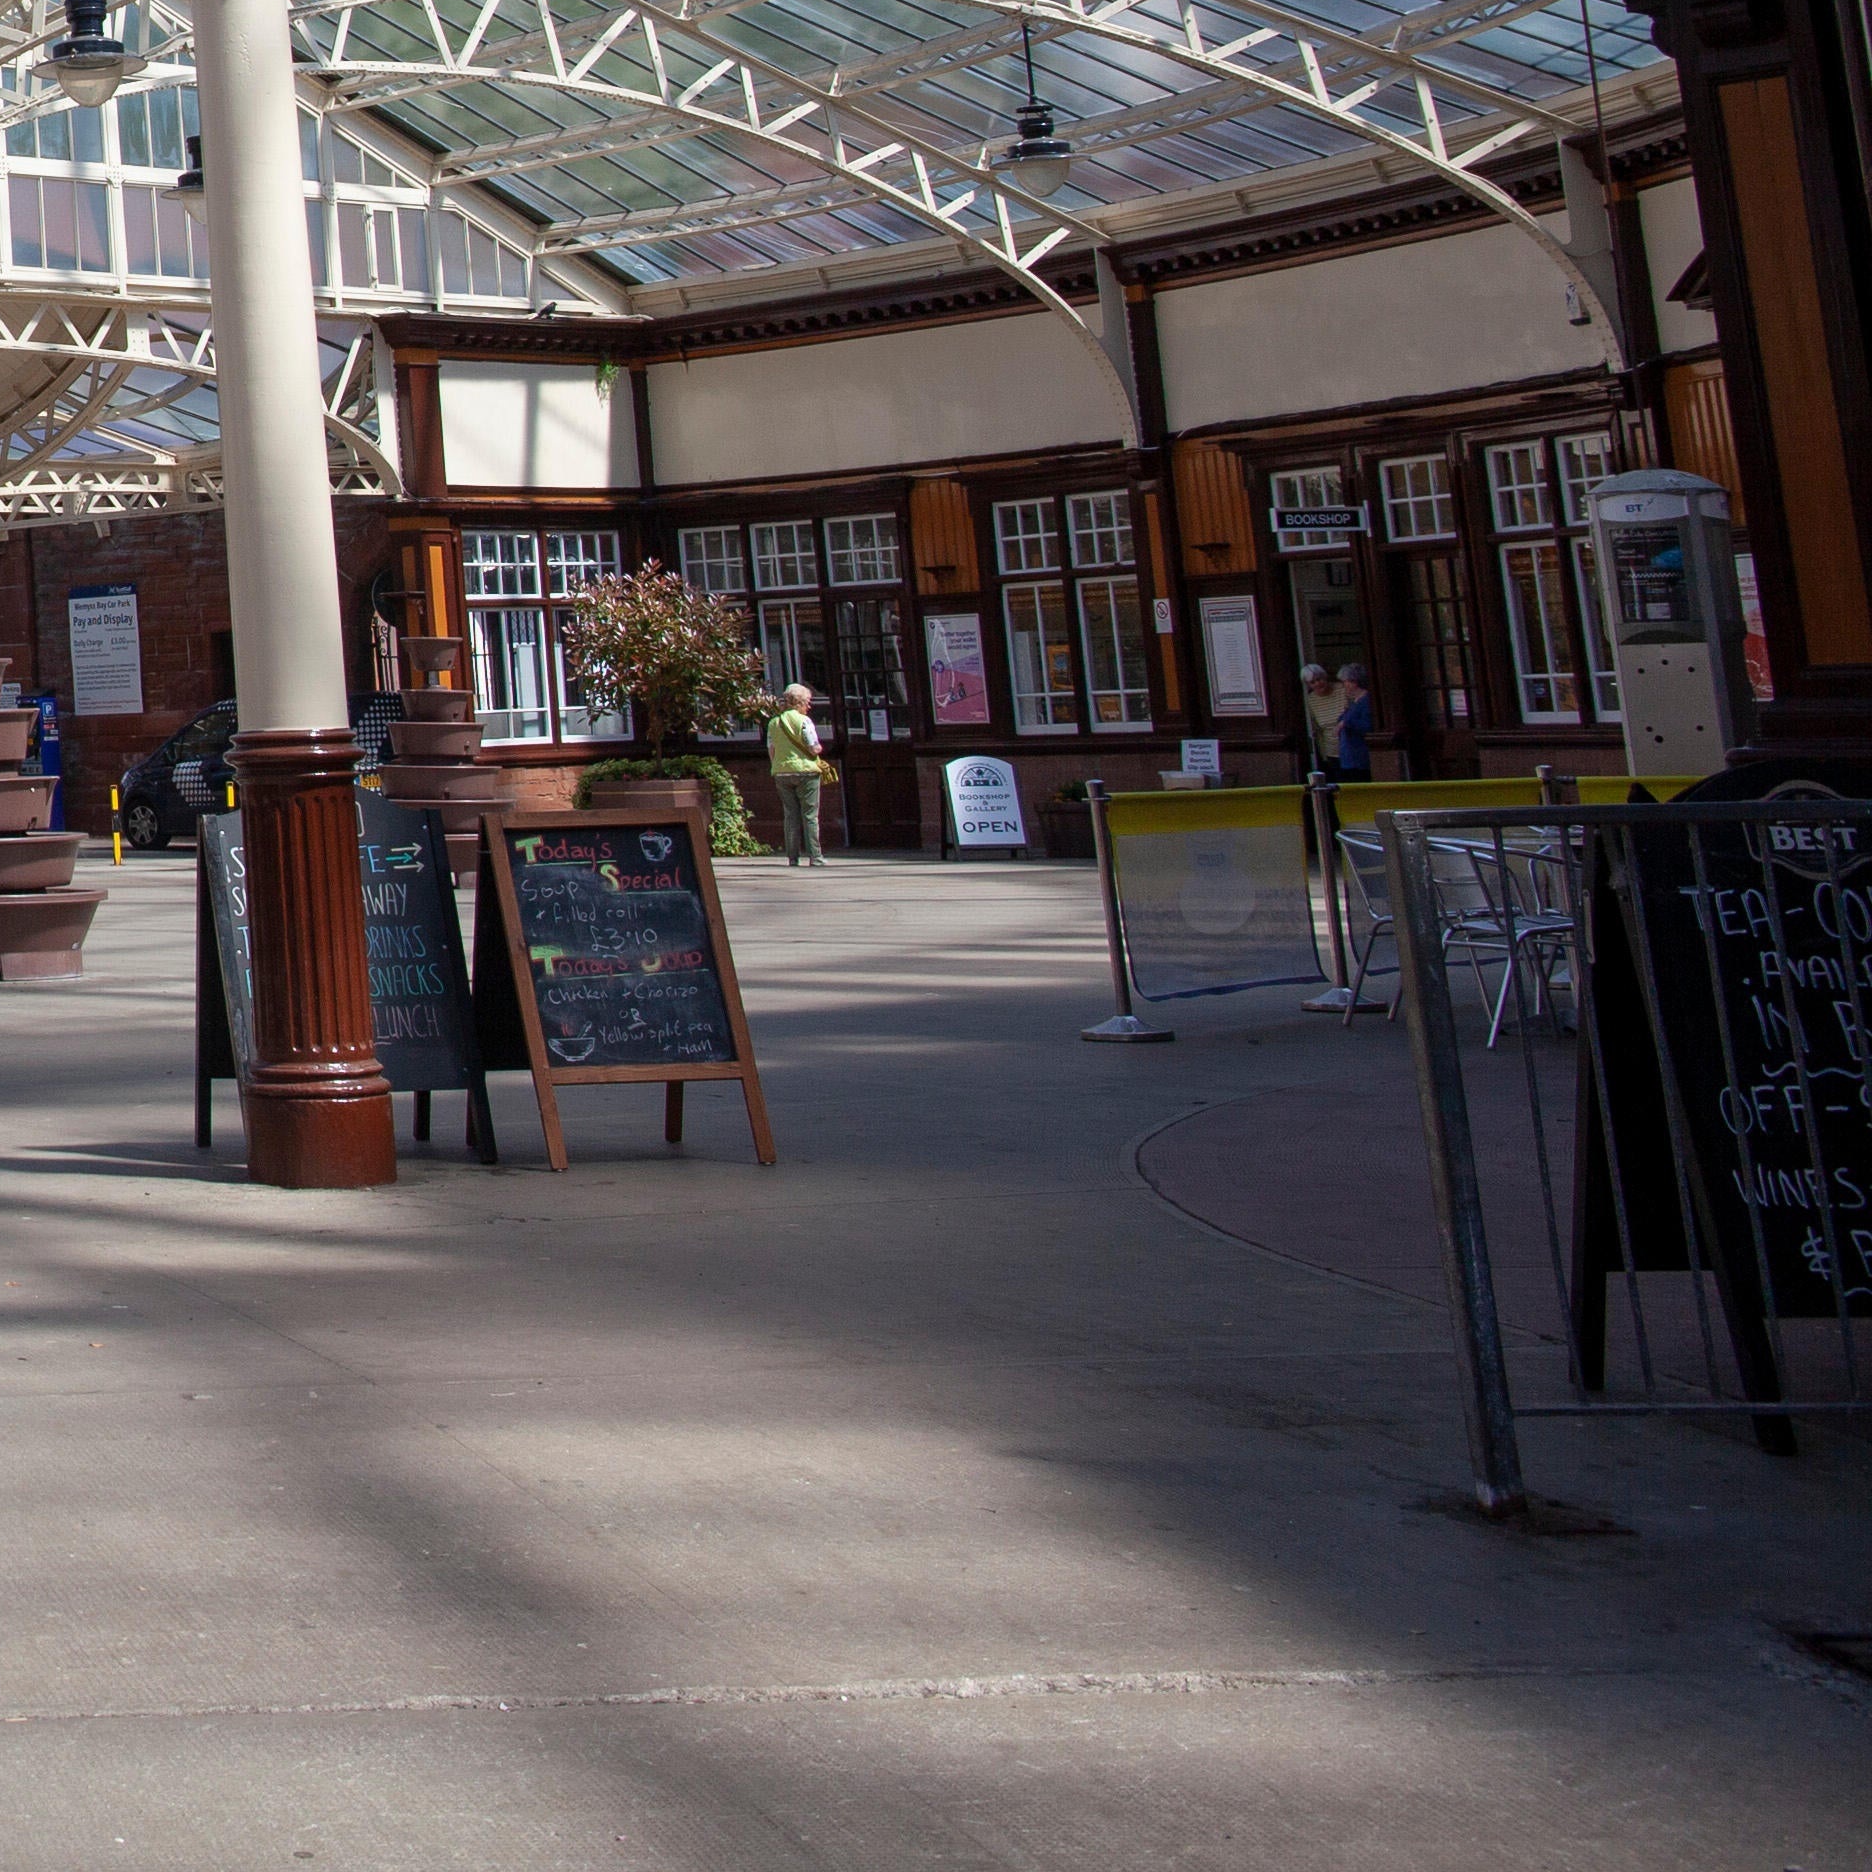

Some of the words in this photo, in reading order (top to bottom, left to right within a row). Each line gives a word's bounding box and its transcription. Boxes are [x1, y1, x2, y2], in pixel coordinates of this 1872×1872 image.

[1285, 514, 1351, 525] BOOKSHOP
[1625, 504, 1644, 513] BT
[96, 602, 106, 610] Bay
[108, 600, 116, 608] Car
[117, 599, 131, 607] Park
[73, 616, 86, 628] Pay
[87, 614, 102, 626] and
[103, 613, 134, 626] Display
[962, 821, 1018, 833] OPEN
[1768, 826, 1857, 850] BEST
[515, 833, 613, 872] Today's
[600, 864, 683, 891] Special
[520, 879, 579, 902] Soup
[552, 902, 598, 923] filled
[529, 945, 630, 977] Today's
[548, 985, 608, 1005] Chicken
[372, 1003, 441, 1039] LUNCH
[598, 1025, 645, 1044] Yellow
[1720, 1084, 1805, 1135] OFF
[1732, 1163, 1867, 1209] WINES
